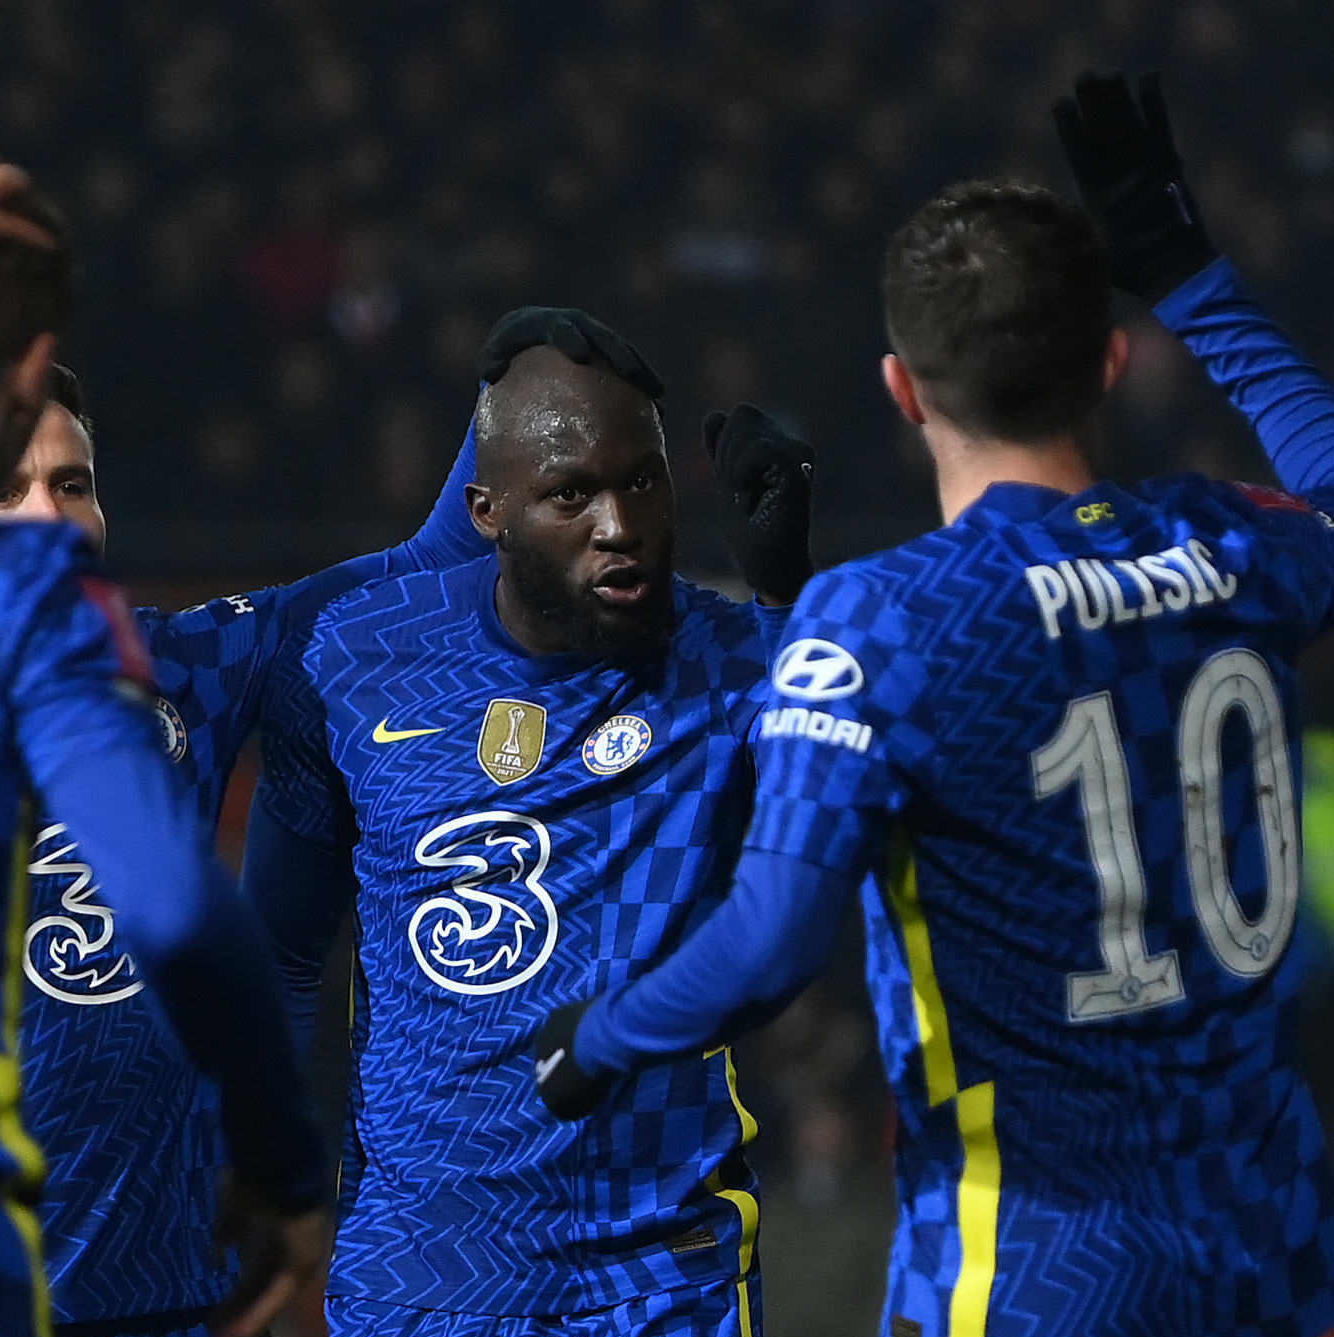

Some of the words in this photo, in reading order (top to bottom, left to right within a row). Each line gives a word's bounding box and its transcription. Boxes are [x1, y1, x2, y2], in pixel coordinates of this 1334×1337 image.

[1075, 502, 1115, 525] CFC
[1024, 538, 1238, 640] PULISIC
[597, 718, 642, 734] CHELSEA
[494, 753, 522, 768] FIFA
[1030, 647, 1304, 1024] 10
